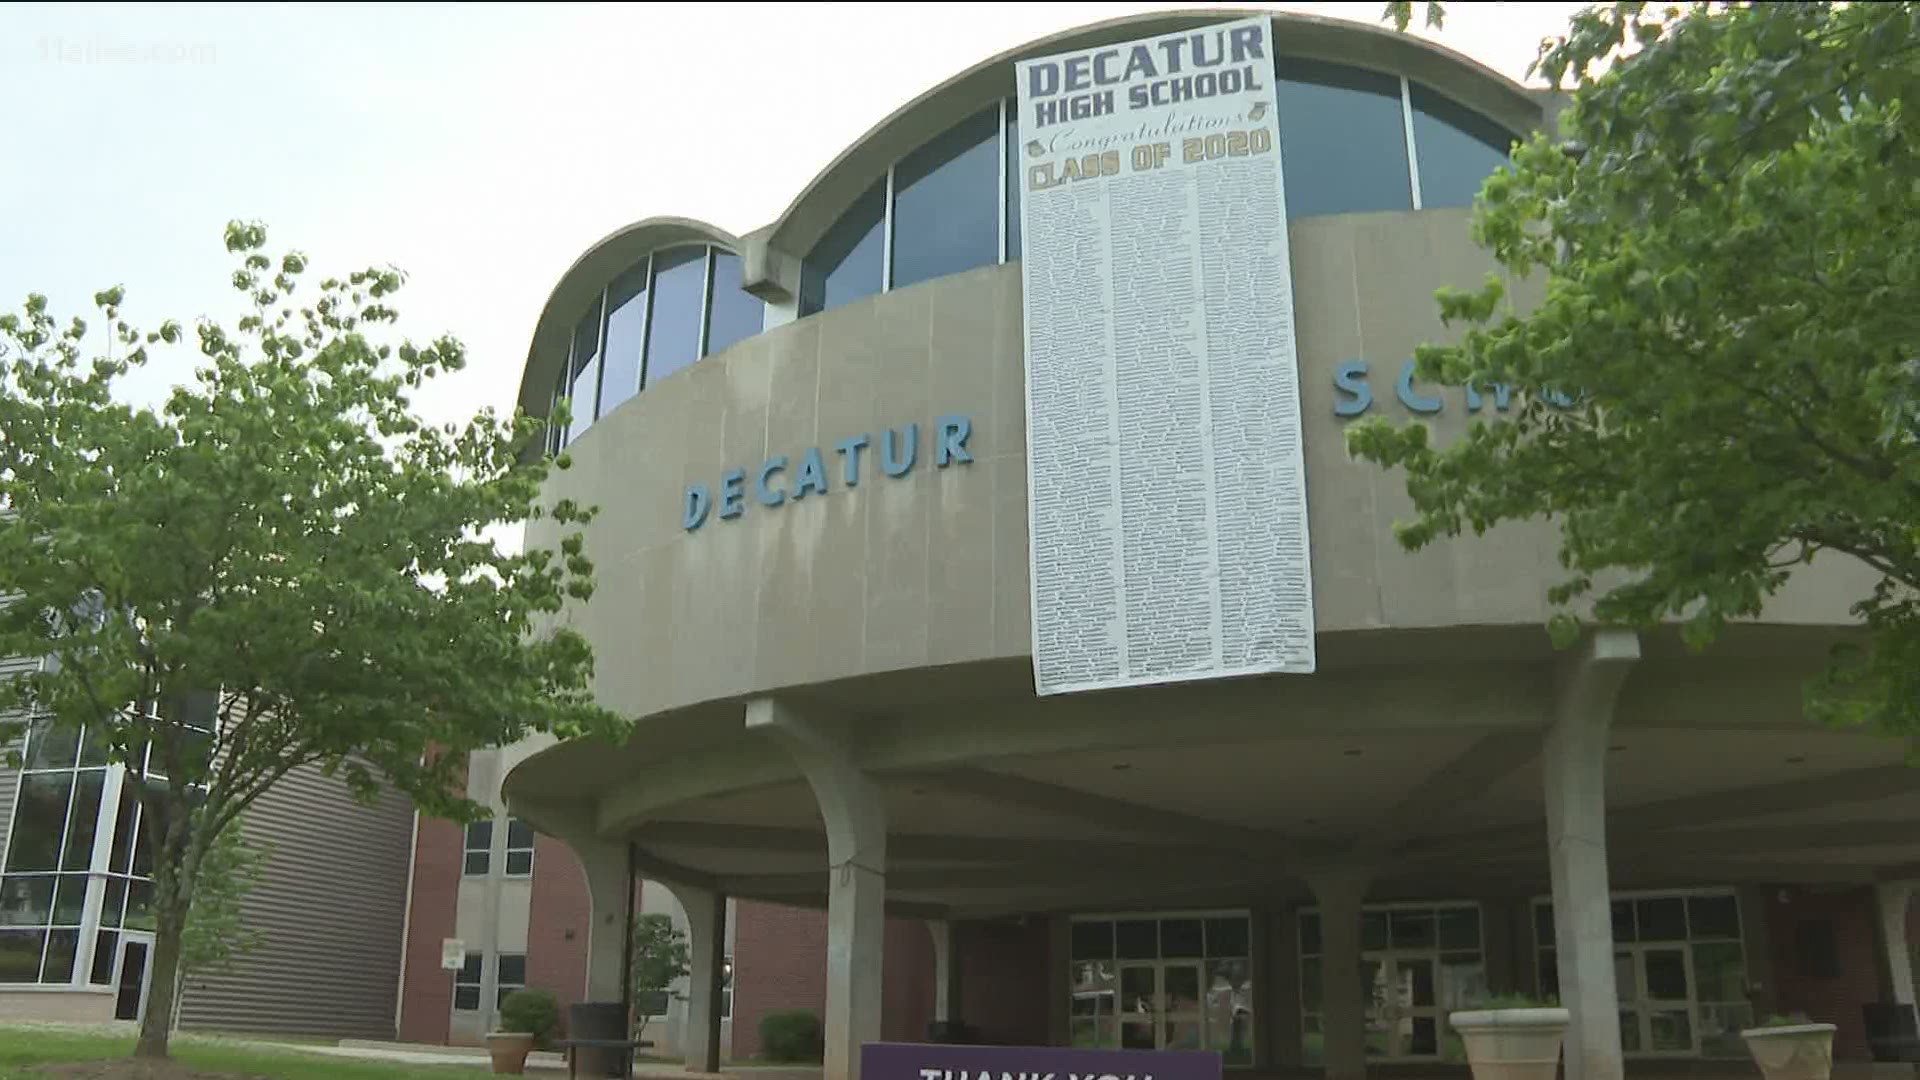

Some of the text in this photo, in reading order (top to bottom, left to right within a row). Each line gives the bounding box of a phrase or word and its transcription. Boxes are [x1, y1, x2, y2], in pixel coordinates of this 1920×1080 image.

[1029, 25, 1264, 98] DECATUR
[1035, 65, 1262, 128] HIGH SCHOOL
[1028, 127, 1272, 192] CLASS OF 2020
[1050, 111, 1243, 151] Congratulations
[683, 415, 975, 533] DECATUR
